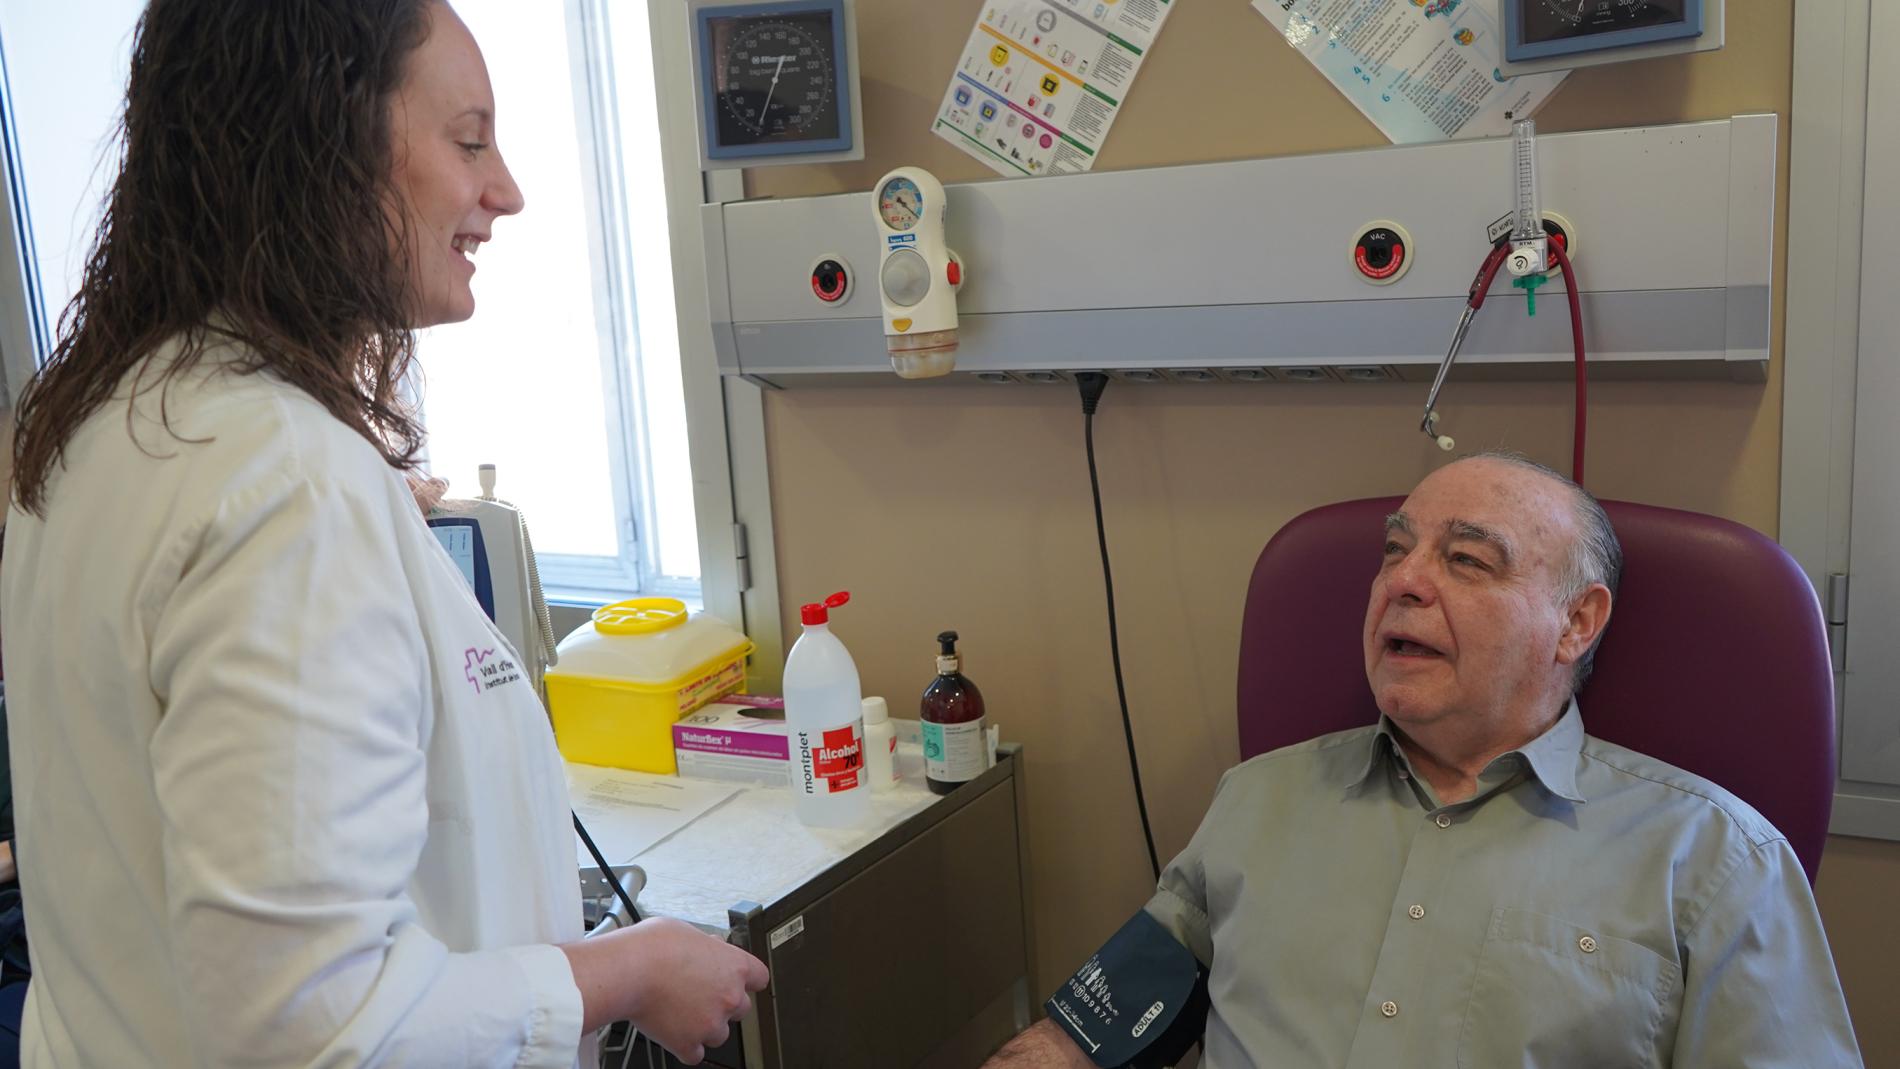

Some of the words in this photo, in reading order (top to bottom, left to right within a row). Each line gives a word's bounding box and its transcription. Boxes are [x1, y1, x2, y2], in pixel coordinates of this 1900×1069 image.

[1353, 65, 1361, 74] 4
[1362, 75, 1370, 84] 5
[1382, 93, 1391, 102] 6
[480, 663, 497, 677] Vall
[819, 741, 859, 760] Alcohol
[799, 732, 813, 793] montplet
[1082, 993, 1090, 1003] 10
[1134, 1011, 1154, 1034] ADULT
